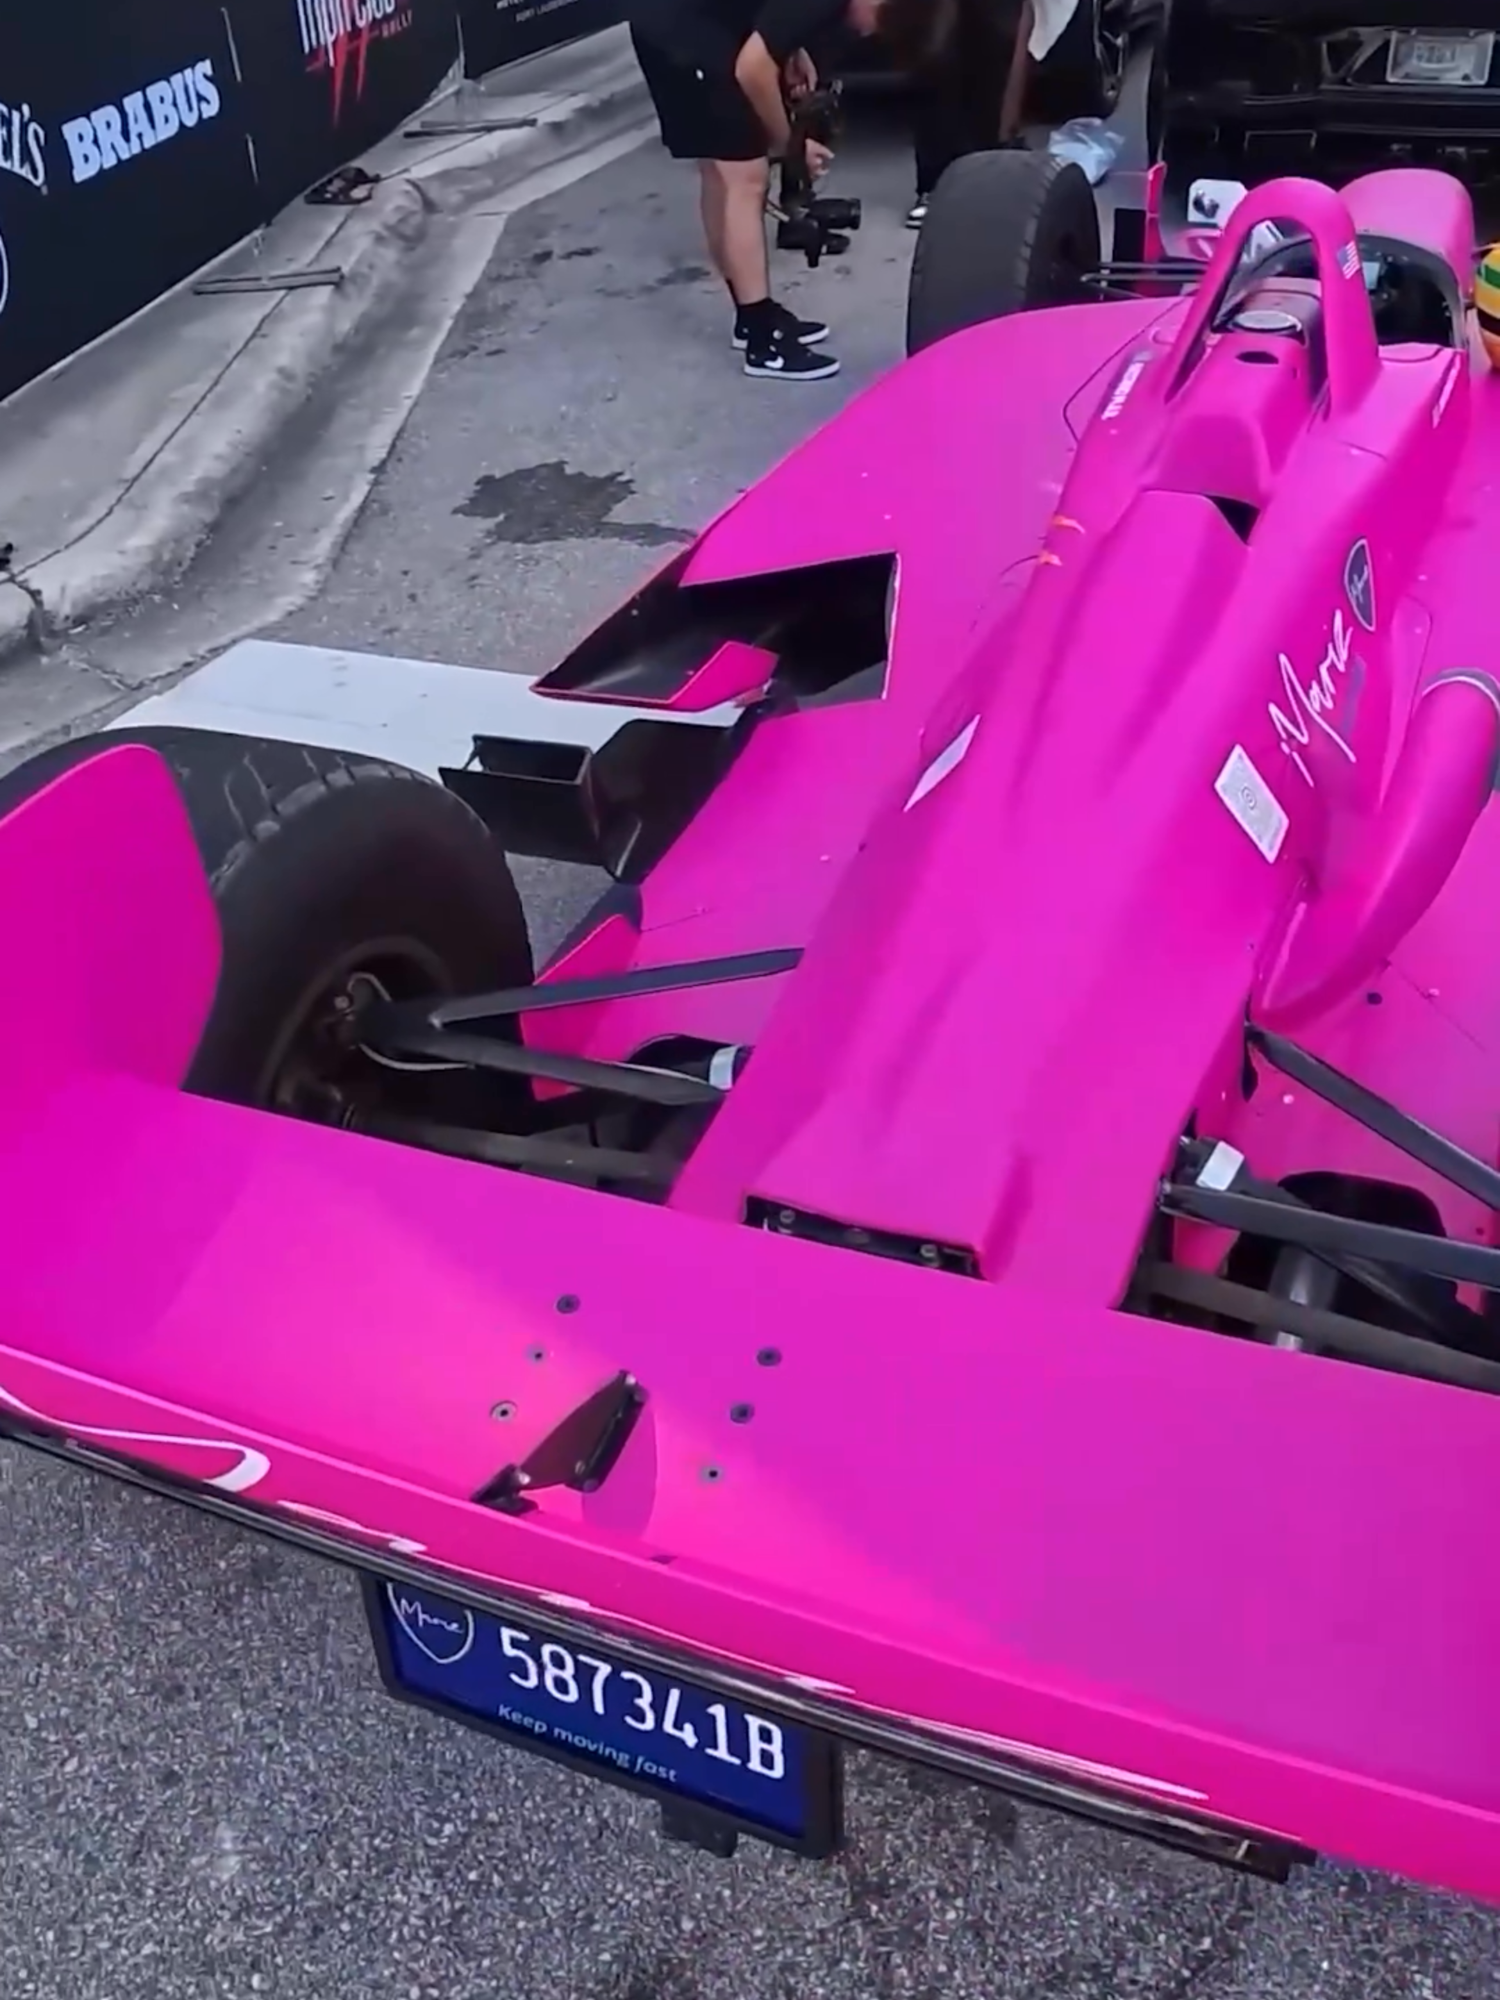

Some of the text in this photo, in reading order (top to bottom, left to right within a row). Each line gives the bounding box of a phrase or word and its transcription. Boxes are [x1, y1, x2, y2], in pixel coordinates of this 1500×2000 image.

[61, 58, 220, 184] BRABUS
[498, 1703, 678, 1783] Keep moving fast
[499, 1625, 786, 1780] 587341B
